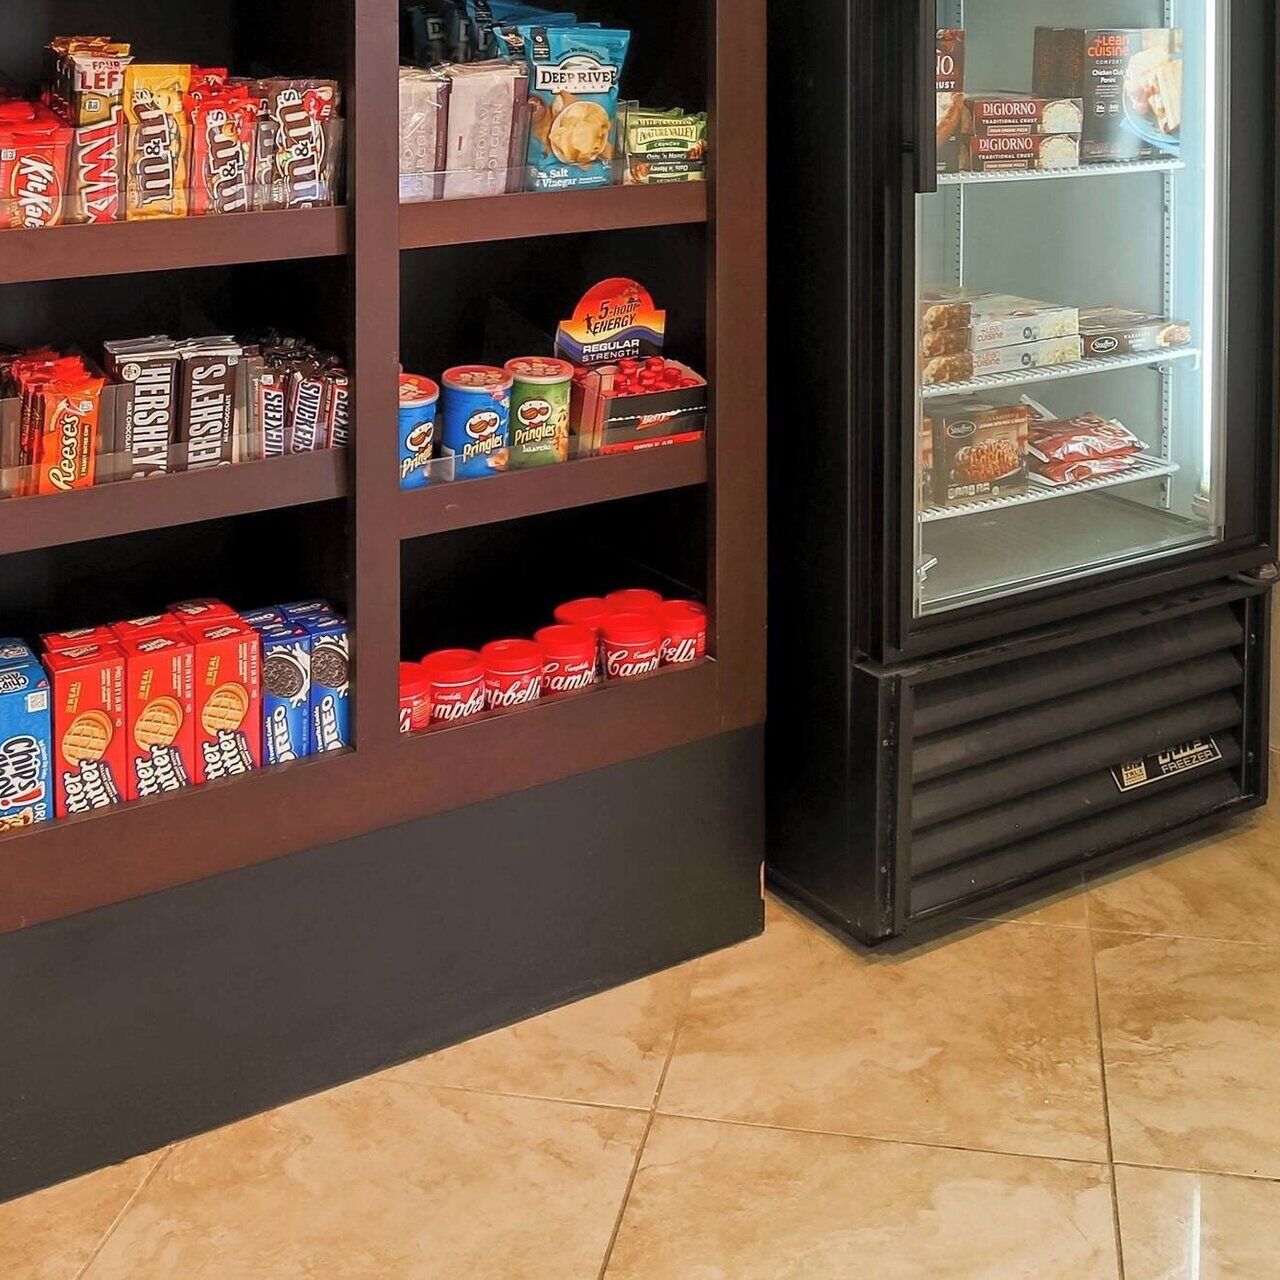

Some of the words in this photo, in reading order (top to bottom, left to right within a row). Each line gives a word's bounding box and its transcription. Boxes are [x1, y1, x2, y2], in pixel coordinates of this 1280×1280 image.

[91, 60, 120, 71] FOUR
[540, 70, 577, 86] DEEP
[578, 70, 618, 87] RIVER
[982, 101, 1037, 117] DIGIORNO
[1020, 117, 1039, 125] CRUST
[486, 102, 503, 181] POPCORN
[639, 127, 669, 140] NATURE
[669, 127, 696, 139] VALLEY
[978, 137, 1034, 152] DIGIORNO
[76, 105, 125, 224] TWIX
[977, 153, 1015, 161] TRADITIONAL
[1016, 152, 1035, 160] CRUST
[20, 156, 55, 193] Kit
[541, 176, 578, 189] Vinegar
[549, 168, 569, 180] Salt
[598, 298, 641, 320] 5-hour
[591, 314, 636, 335] ENERGY
[581, 348, 640, 363] STRENGTH
[582, 339, 641, 354] REGULAR
[292, 381, 322, 453] SNICKERS
[514, 422, 556, 445] Pringles
[47, 413, 79, 491] Reese's
[462, 433, 504, 463] Pringles
[1, 736, 41, 792] Chips
[1161, 750, 1215, 774] FREEZER
